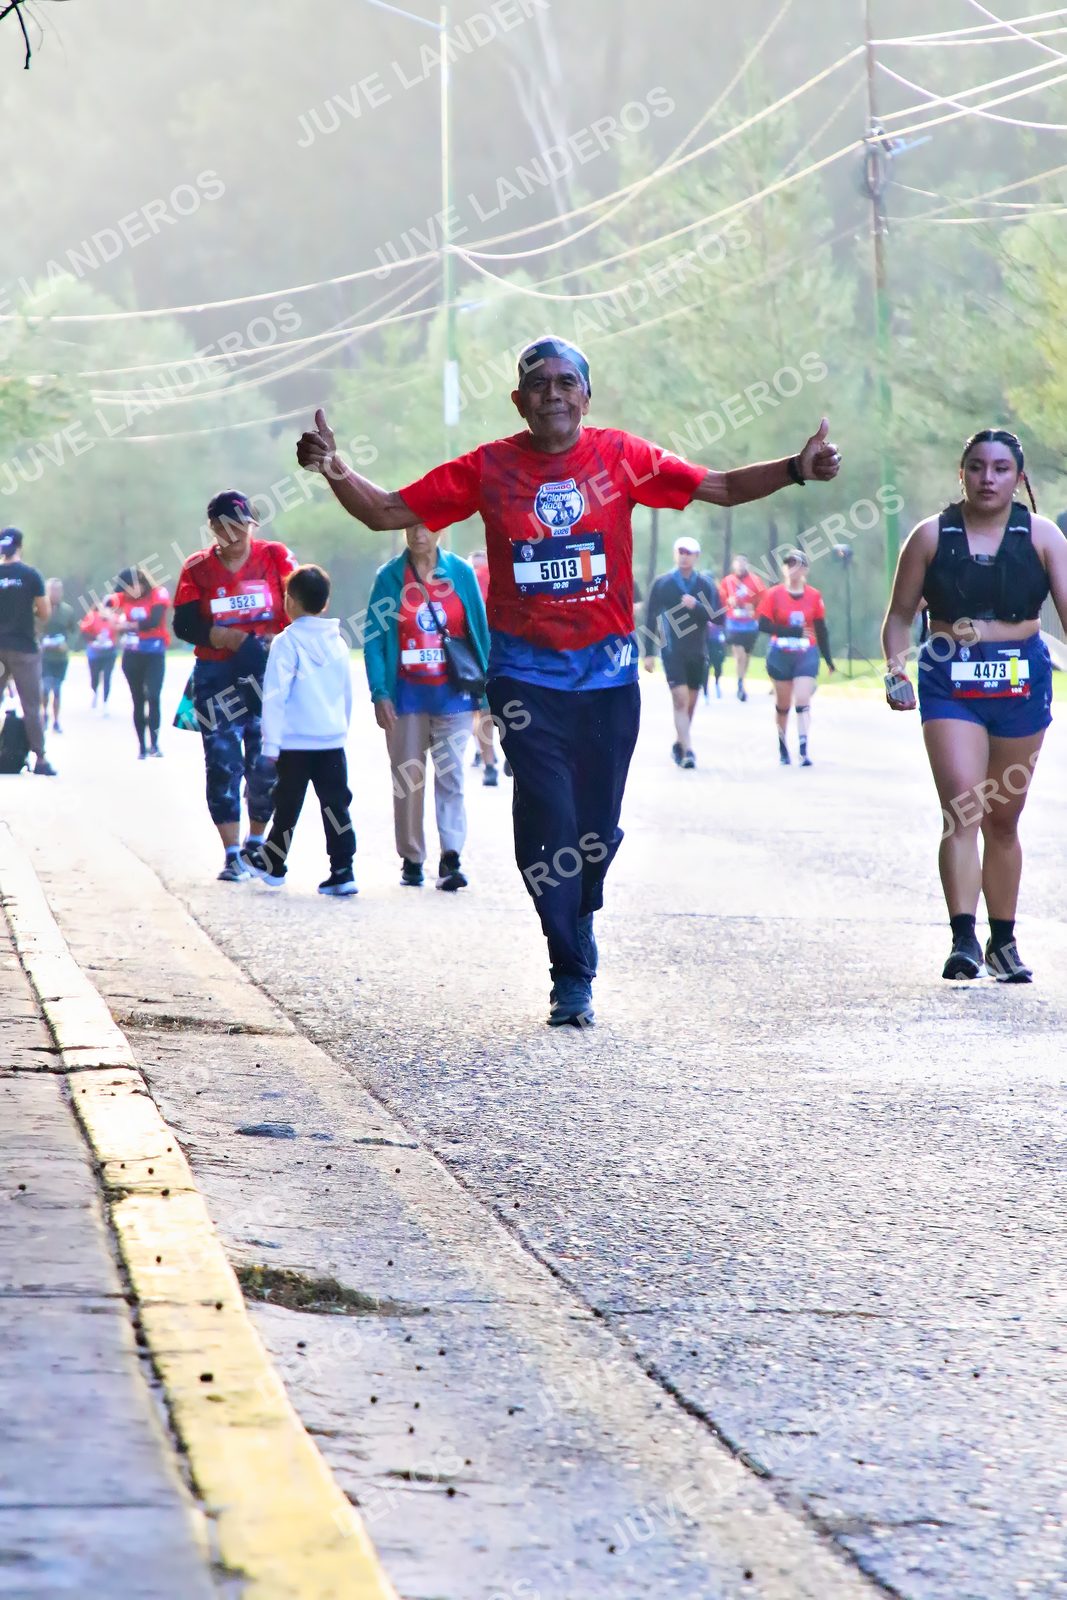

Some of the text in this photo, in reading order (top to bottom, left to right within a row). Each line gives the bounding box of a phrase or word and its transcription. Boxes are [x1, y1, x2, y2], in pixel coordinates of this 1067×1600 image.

[547, 493, 572, 502] Global
[542, 501, 563, 510] Race
[540, 559, 578, 580] 5013
[585, 585, 599, 593] 10K
[229, 594, 256, 609] 3523
[974, 663, 1006, 678] 4473
